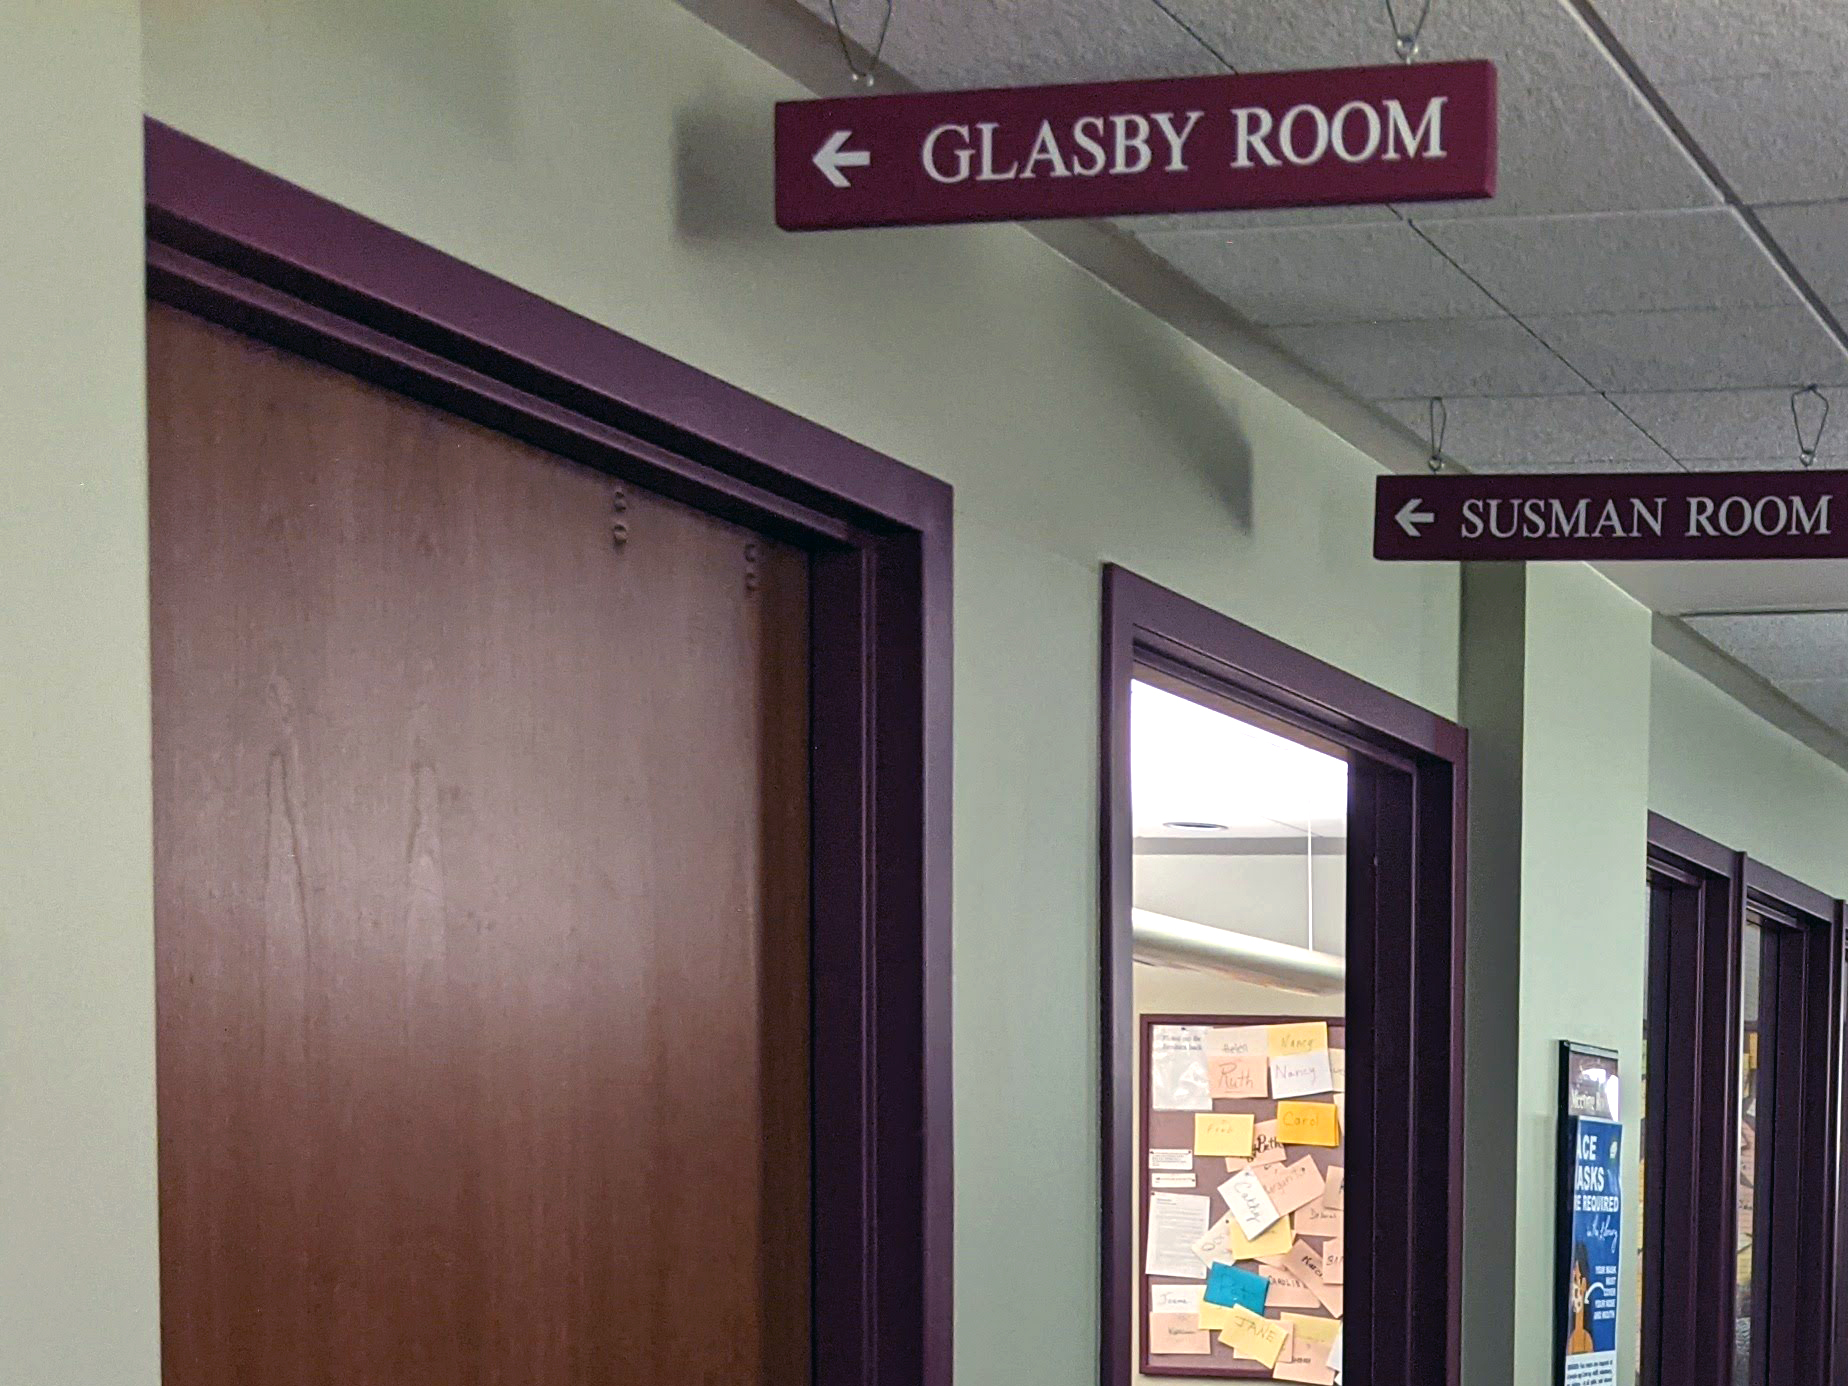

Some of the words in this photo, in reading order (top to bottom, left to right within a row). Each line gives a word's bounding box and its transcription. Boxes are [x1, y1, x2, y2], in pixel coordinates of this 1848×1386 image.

[921, 110, 1203, 184] GLASBY
[1229, 96, 1449, 170] ROOM
[1461, 498, 1668, 539] SUSMAN
[1685, 495, 1834, 537] ROOM
[1218, 1062, 1254, 1089] Ruth
[1275, 1065, 1317, 1084] Nancy
[1283, 1111, 1320, 1127] Carol
[1578, 1134, 1598, 1160] ACE
[1576, 1166, 1605, 1191] ASKS
[1583, 1196, 1619, 1212] REQUIRED
[1235, 1315, 1276, 1343] JANE
